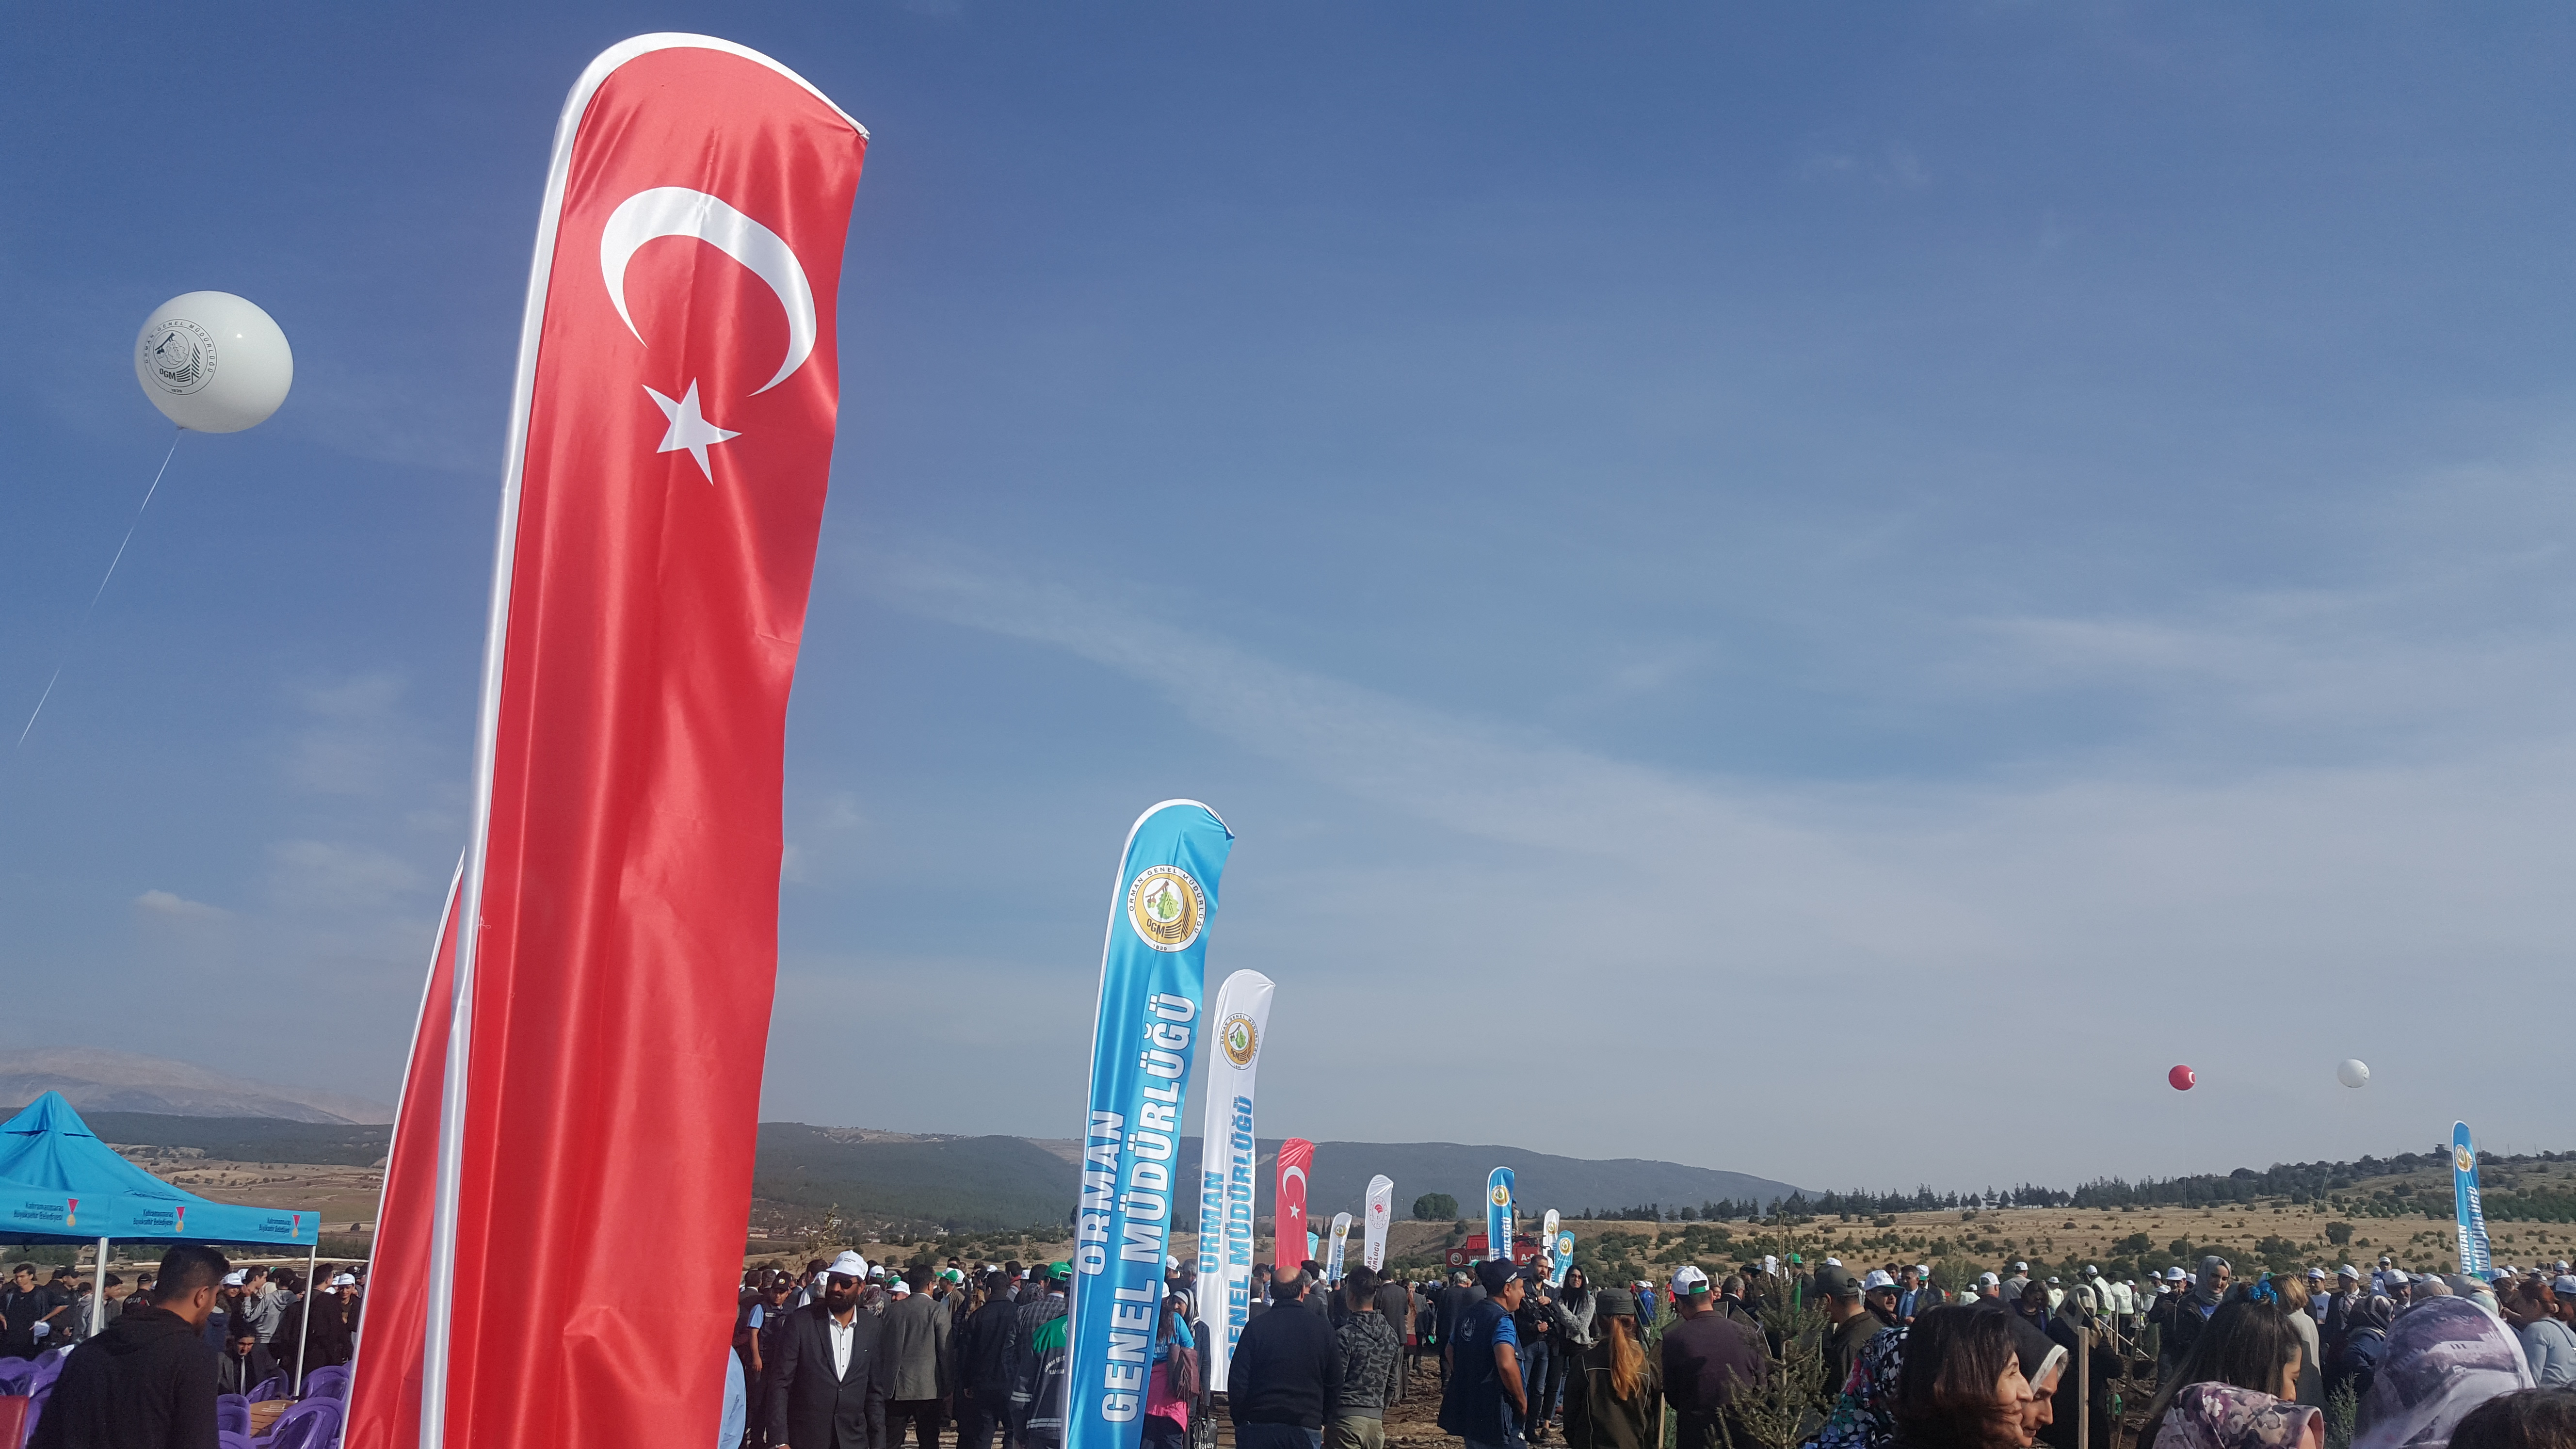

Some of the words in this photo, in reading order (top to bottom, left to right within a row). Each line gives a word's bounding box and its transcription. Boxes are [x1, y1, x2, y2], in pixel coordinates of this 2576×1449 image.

[157, 321, 184, 331] GENEL
[159, 368, 176, 381] OGM
[1129, 877, 1143, 912] ORMAN
[1147, 867, 1177, 875] GENEL
[1182, 873, 1204, 934] MÜDÜRLÜĞÜ
[1146, 918, 1165, 937] OGM
[1230, 1048, 1240, 1061] OGM
[1118, 992, 1196, 1264] MÜDÜRLÜĞÜ
[1079, 1110, 1124, 1276] ORMAN
[1225, 1095, 1253, 1266] MÜDÜRLÜĞÜ
[1199, 1171, 1224, 1273] ORMAN
[1501, 1217, 1511, 1259] ÜRLÜĞÜ
[2459, 1224, 2472, 1274] ORMAN
[2466, 1185, 2489, 1272] MÜDÜRLÜĞÜ
[1101, 1279, 1157, 1423] GENEL
